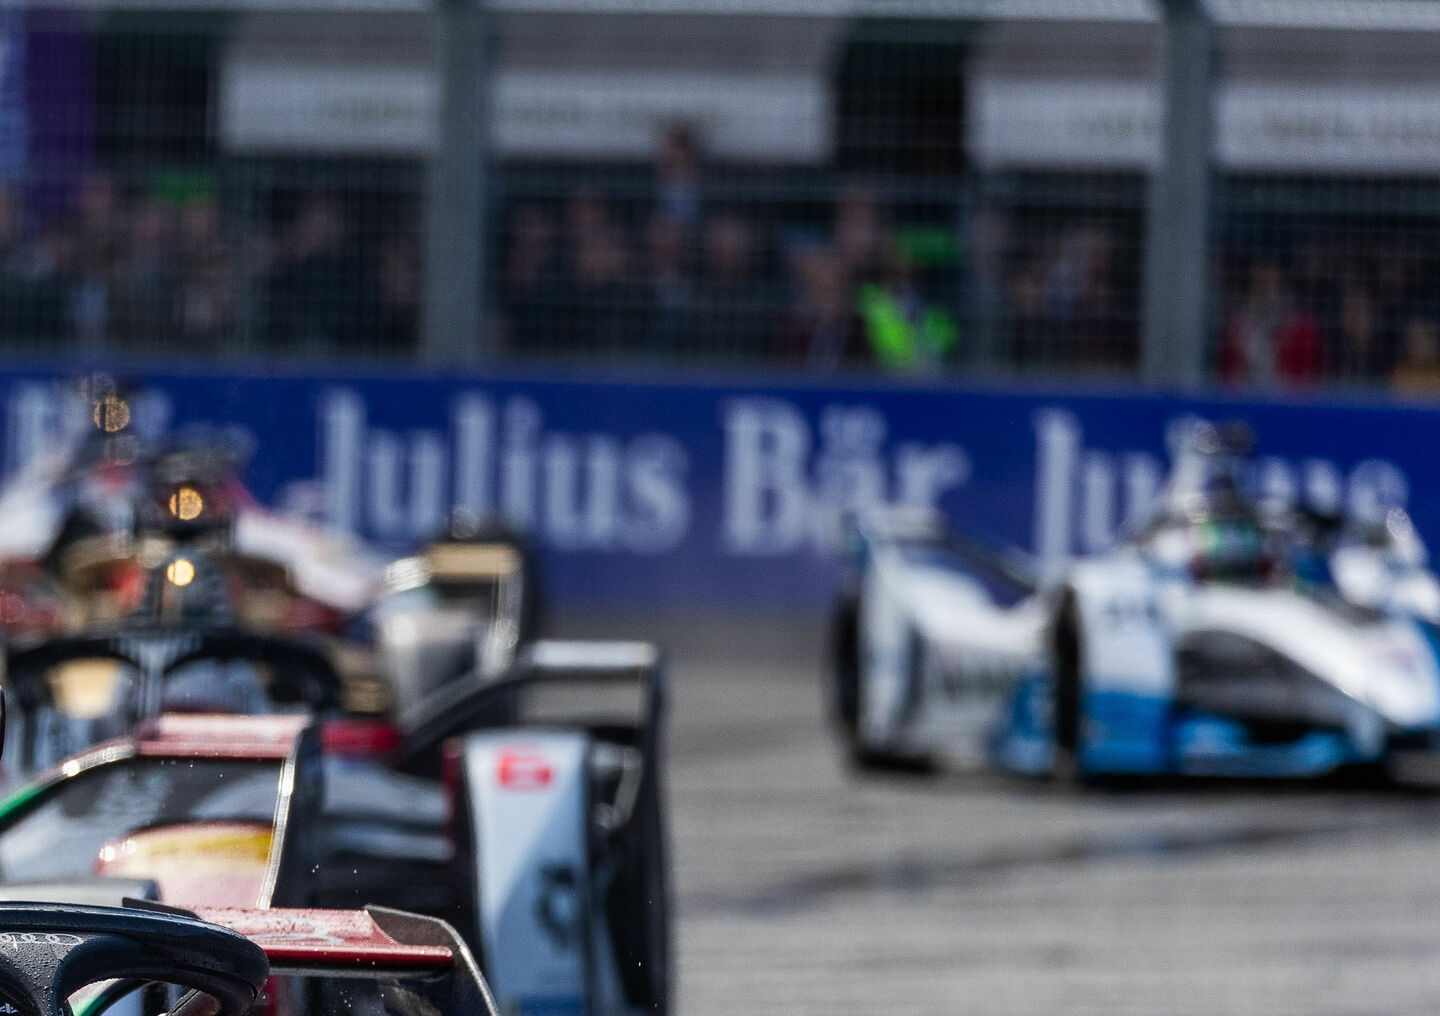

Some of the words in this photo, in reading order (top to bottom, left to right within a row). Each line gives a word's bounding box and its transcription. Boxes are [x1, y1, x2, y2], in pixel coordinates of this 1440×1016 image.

[317, 388, 692, 553] Julius
[722, 395, 968, 558] Bär
[1032, 408, 1410, 590] Julus
